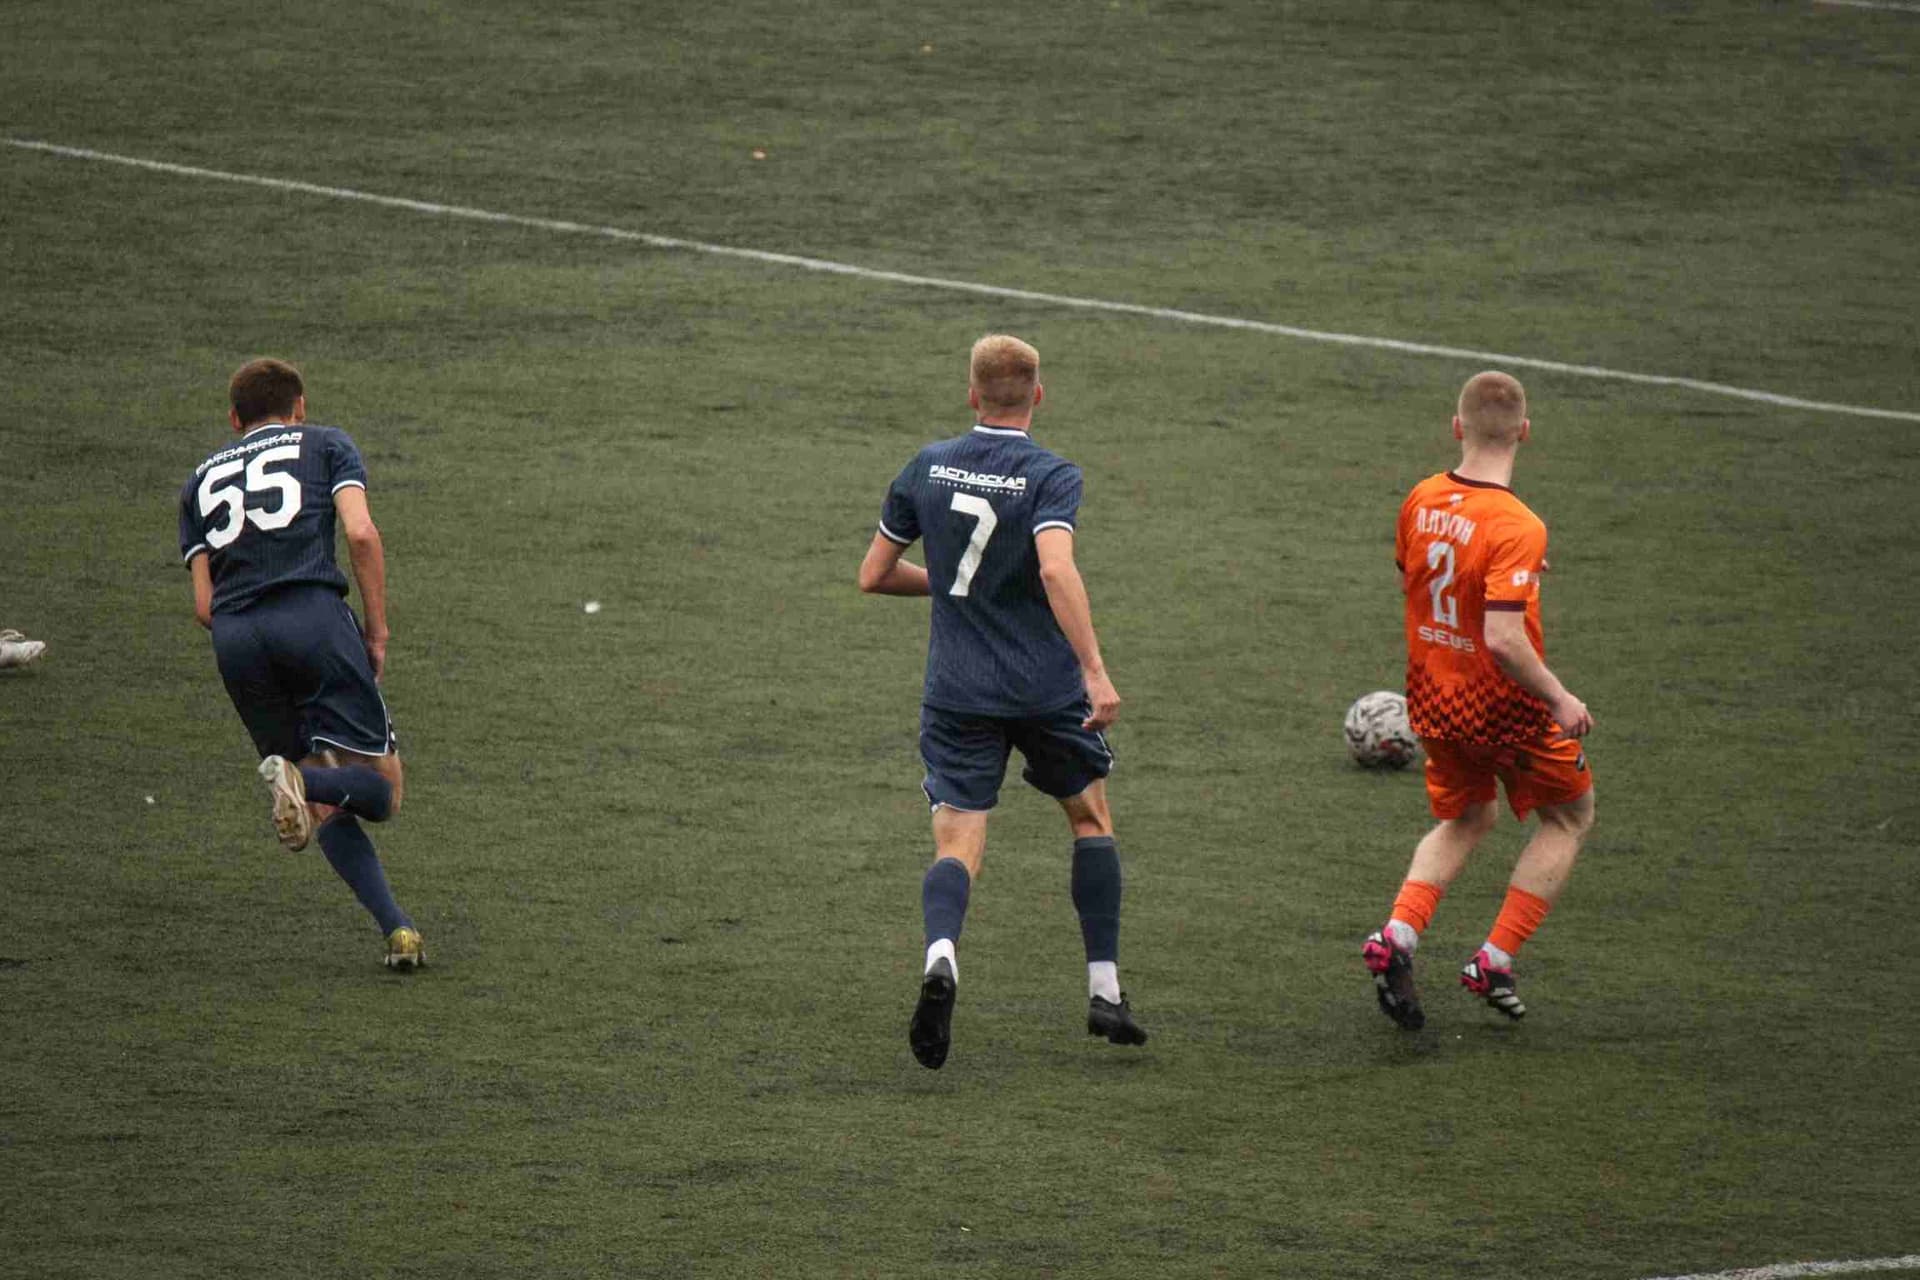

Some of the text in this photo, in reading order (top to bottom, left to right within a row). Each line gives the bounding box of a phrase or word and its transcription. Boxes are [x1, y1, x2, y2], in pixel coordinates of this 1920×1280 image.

[198, 445, 302, 549] 55
[949, 492, 998, 597] 7
[1426, 541, 1458, 629] 2
